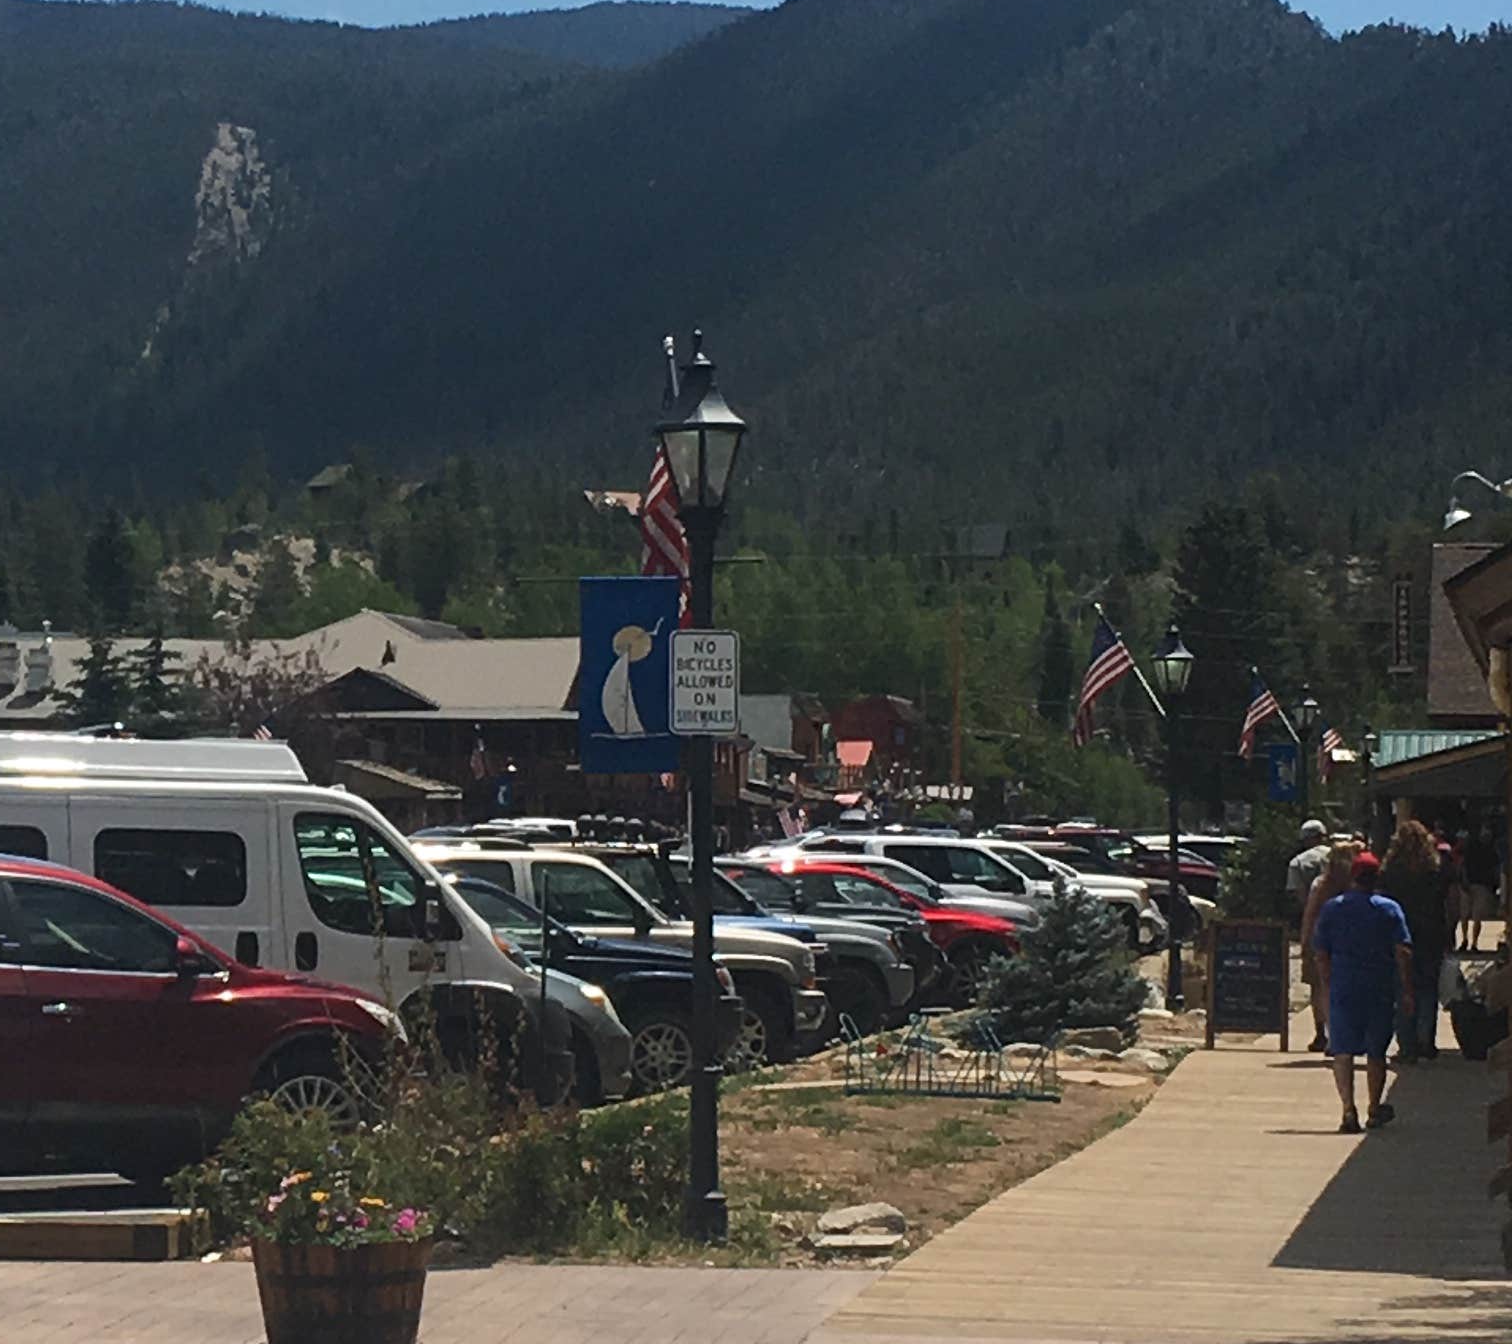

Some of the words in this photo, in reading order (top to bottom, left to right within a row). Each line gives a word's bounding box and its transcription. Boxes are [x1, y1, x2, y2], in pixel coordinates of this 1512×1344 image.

[694, 641, 717, 655] NO
[677, 657, 733, 672] BICYCLES
[677, 675, 734, 689] ALLOWED
[694, 692, 716, 706] ON
[677, 710, 733, 723] SIDEWALKS
